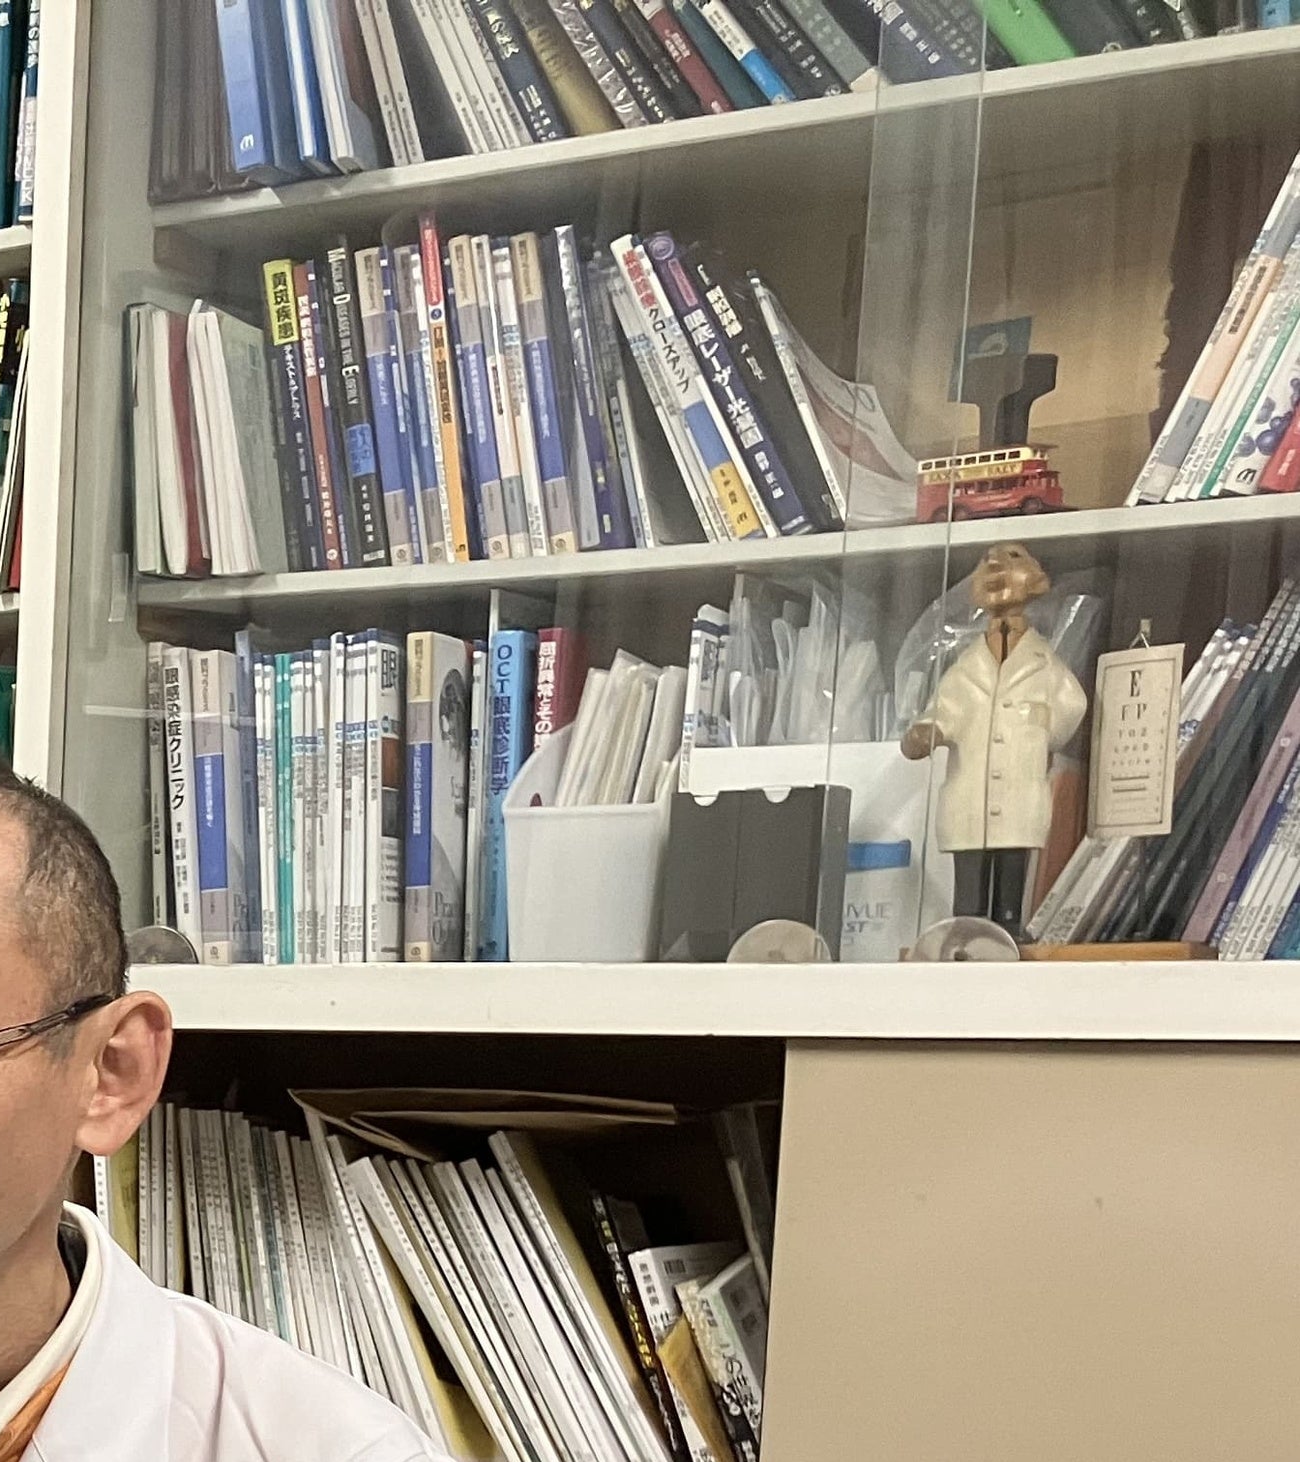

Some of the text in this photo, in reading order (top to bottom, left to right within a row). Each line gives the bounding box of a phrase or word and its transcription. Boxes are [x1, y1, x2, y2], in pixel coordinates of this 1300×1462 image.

[272, 271, 293, 343] 黄斑疾患
[164, 668, 186, 811] 眼感染症クリニック
[534, 641, 557, 751] 屈折異常とその
